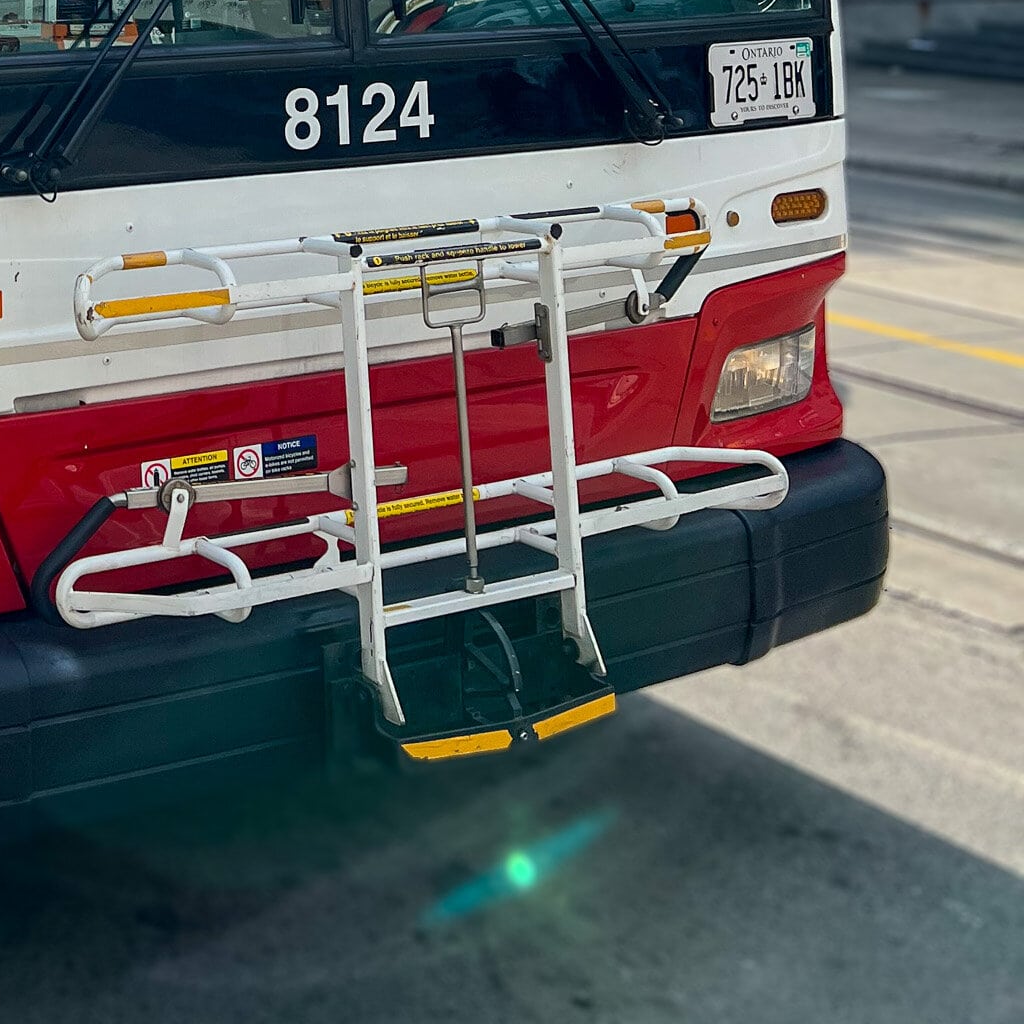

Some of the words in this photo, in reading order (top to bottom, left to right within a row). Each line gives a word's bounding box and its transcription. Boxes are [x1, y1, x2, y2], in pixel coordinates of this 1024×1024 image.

[742, 47, 783, 60] ONTARIO
[722, 63, 759, 105] 725
[773, 60, 806, 100] 1BK
[284, 80, 435, 151] 8124
[394, 254, 412, 263] Push
[414, 252, 429, 261] rack
[431, 251, 444, 259] and
[508, 241, 526, 250] lower
[277, 440, 300, 451] NOTICE
[182, 453, 217, 465] ATTENTION
